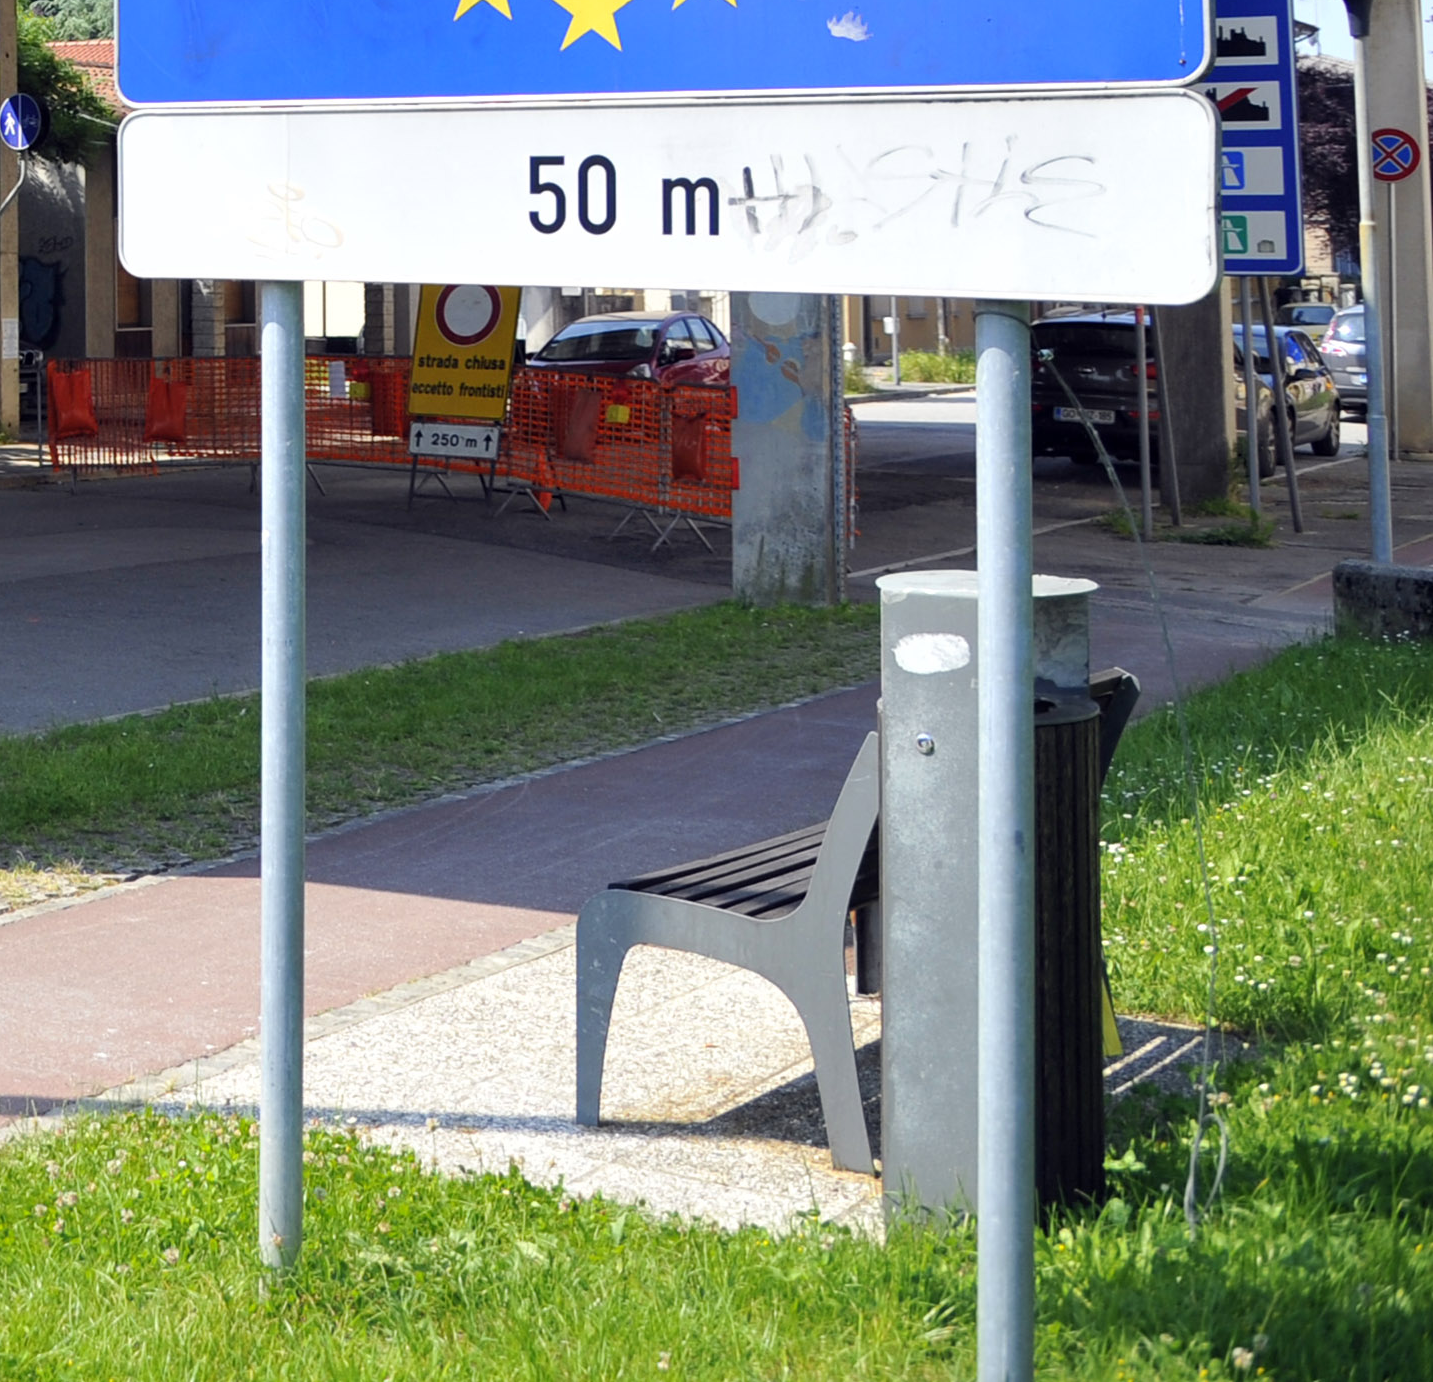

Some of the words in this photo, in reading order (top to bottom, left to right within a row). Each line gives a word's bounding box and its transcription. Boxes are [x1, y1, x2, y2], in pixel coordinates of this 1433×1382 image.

[528, 154, 617, 235] 50
[661, 177, 720, 236] m
[418, 354, 459, 369] strada
[464, 355, 506, 370] chiusa
[412, 381, 454, 396] eccetto
[459, 382, 505, 398] frontisti
[431, 432, 459, 447] 250
[465, 437, 478, 448] m
